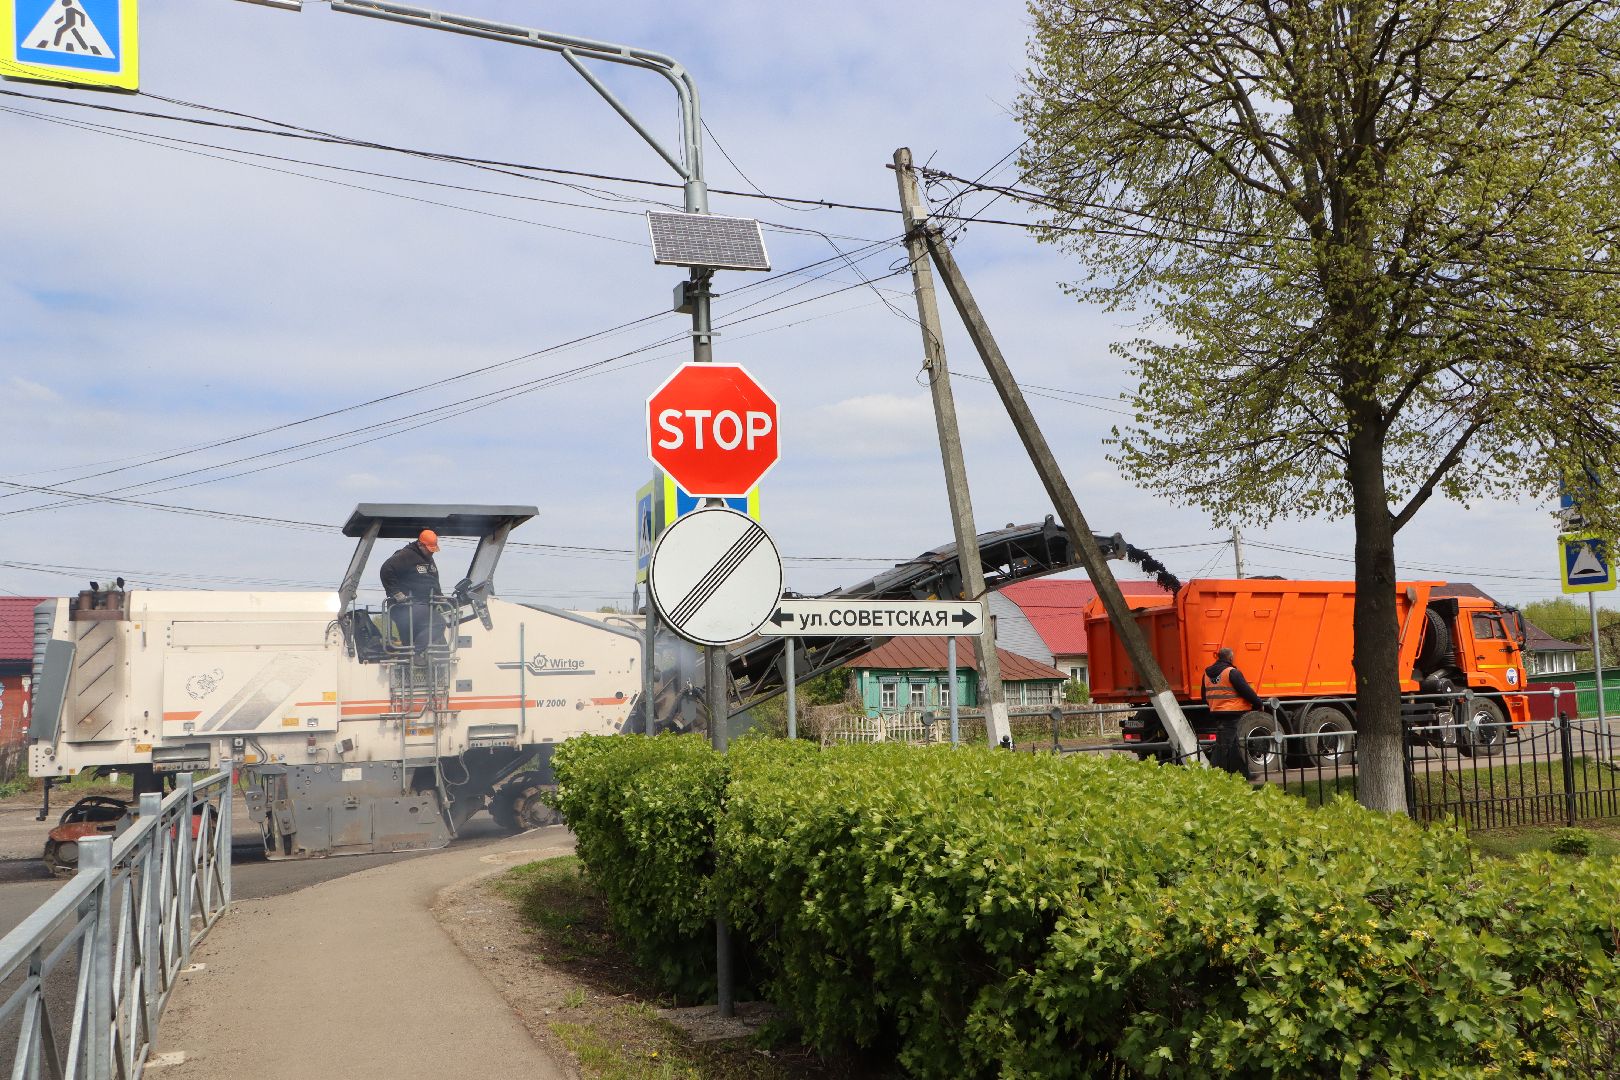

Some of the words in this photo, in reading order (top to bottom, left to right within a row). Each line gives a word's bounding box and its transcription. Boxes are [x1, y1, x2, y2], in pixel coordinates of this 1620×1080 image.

[657, 408, 773, 451] STOP
[799, 610, 948, 631] ул.СОВЕТСКАЯ
[549, 658, 585, 671] Wirtge
[536, 699, 545, 708] W
[546, 698, 567, 708] 2000
